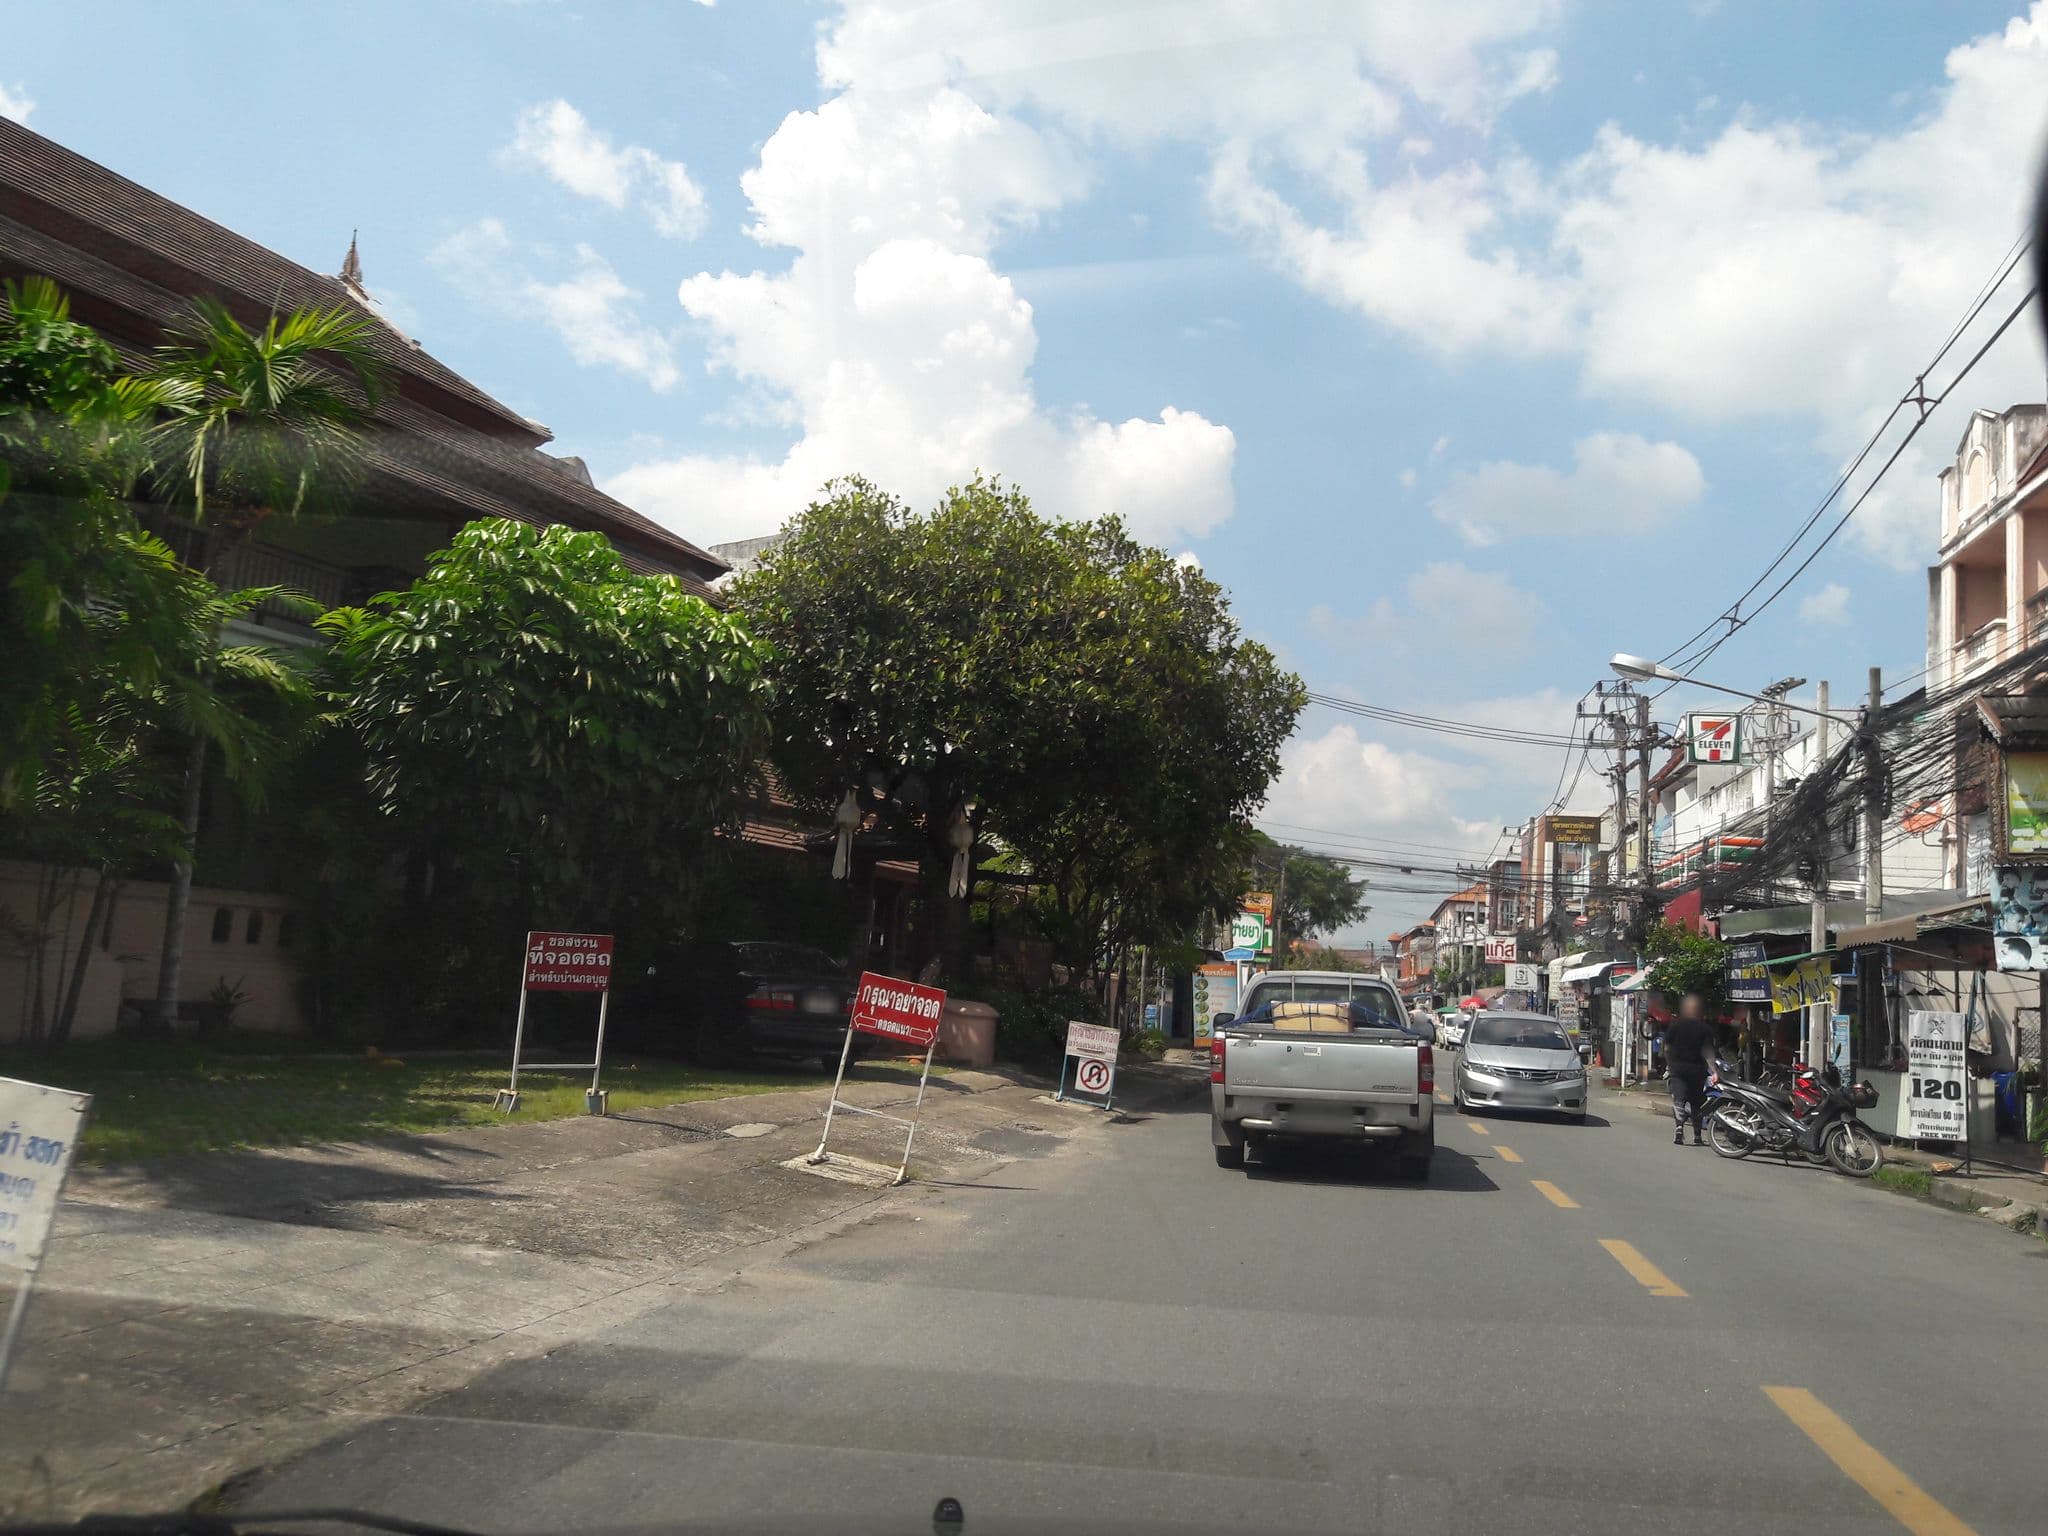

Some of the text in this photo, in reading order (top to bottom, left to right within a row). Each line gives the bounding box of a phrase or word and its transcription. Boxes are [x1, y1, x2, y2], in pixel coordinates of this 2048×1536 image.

[529, 941, 611, 966] ที่จอดรถ
[549, 937, 598, 949] ขอสงวน
[861, 984, 940, 1020] กรุณาอย่าจอด
[1912, 1078, 1962, 1100] 120
